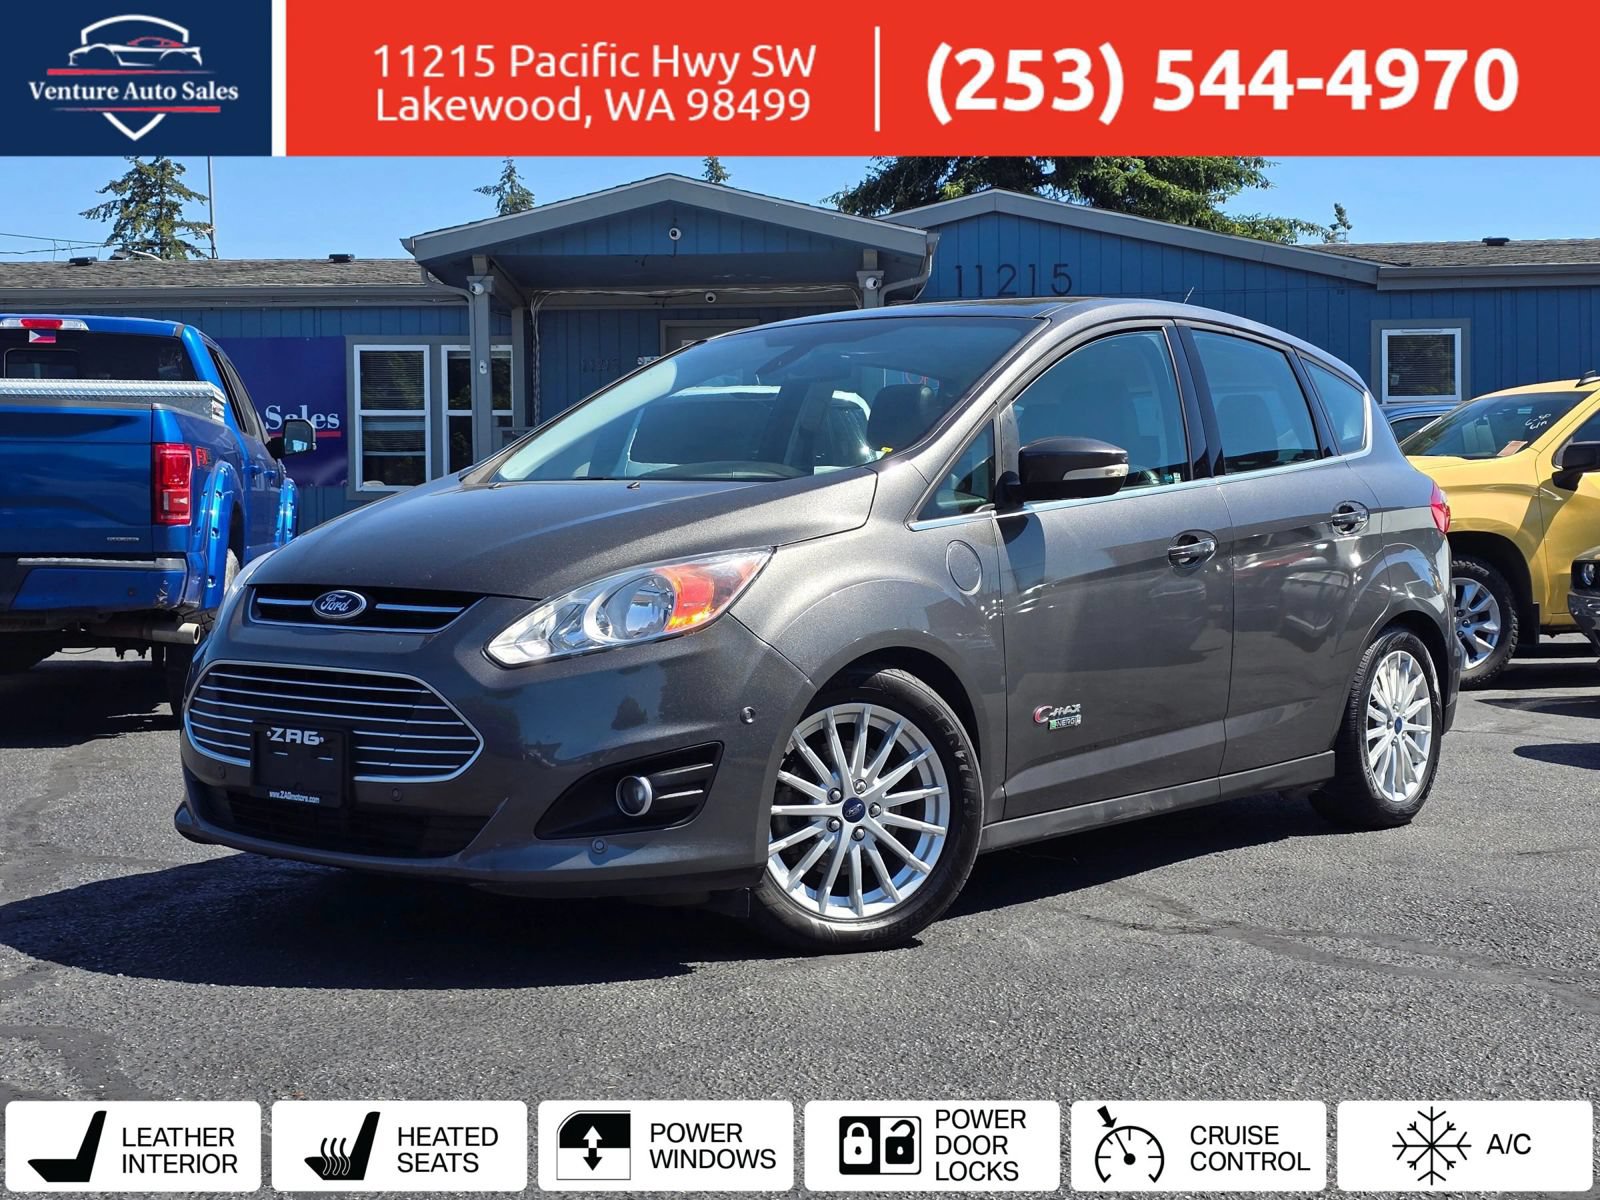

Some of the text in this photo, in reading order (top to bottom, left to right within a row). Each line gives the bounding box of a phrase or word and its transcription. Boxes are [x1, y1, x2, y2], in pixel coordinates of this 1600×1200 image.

[955, 263, 1073, 297] 11215
[320, 593, 352, 612] Ford
[270, 726, 320, 746] ZAG
